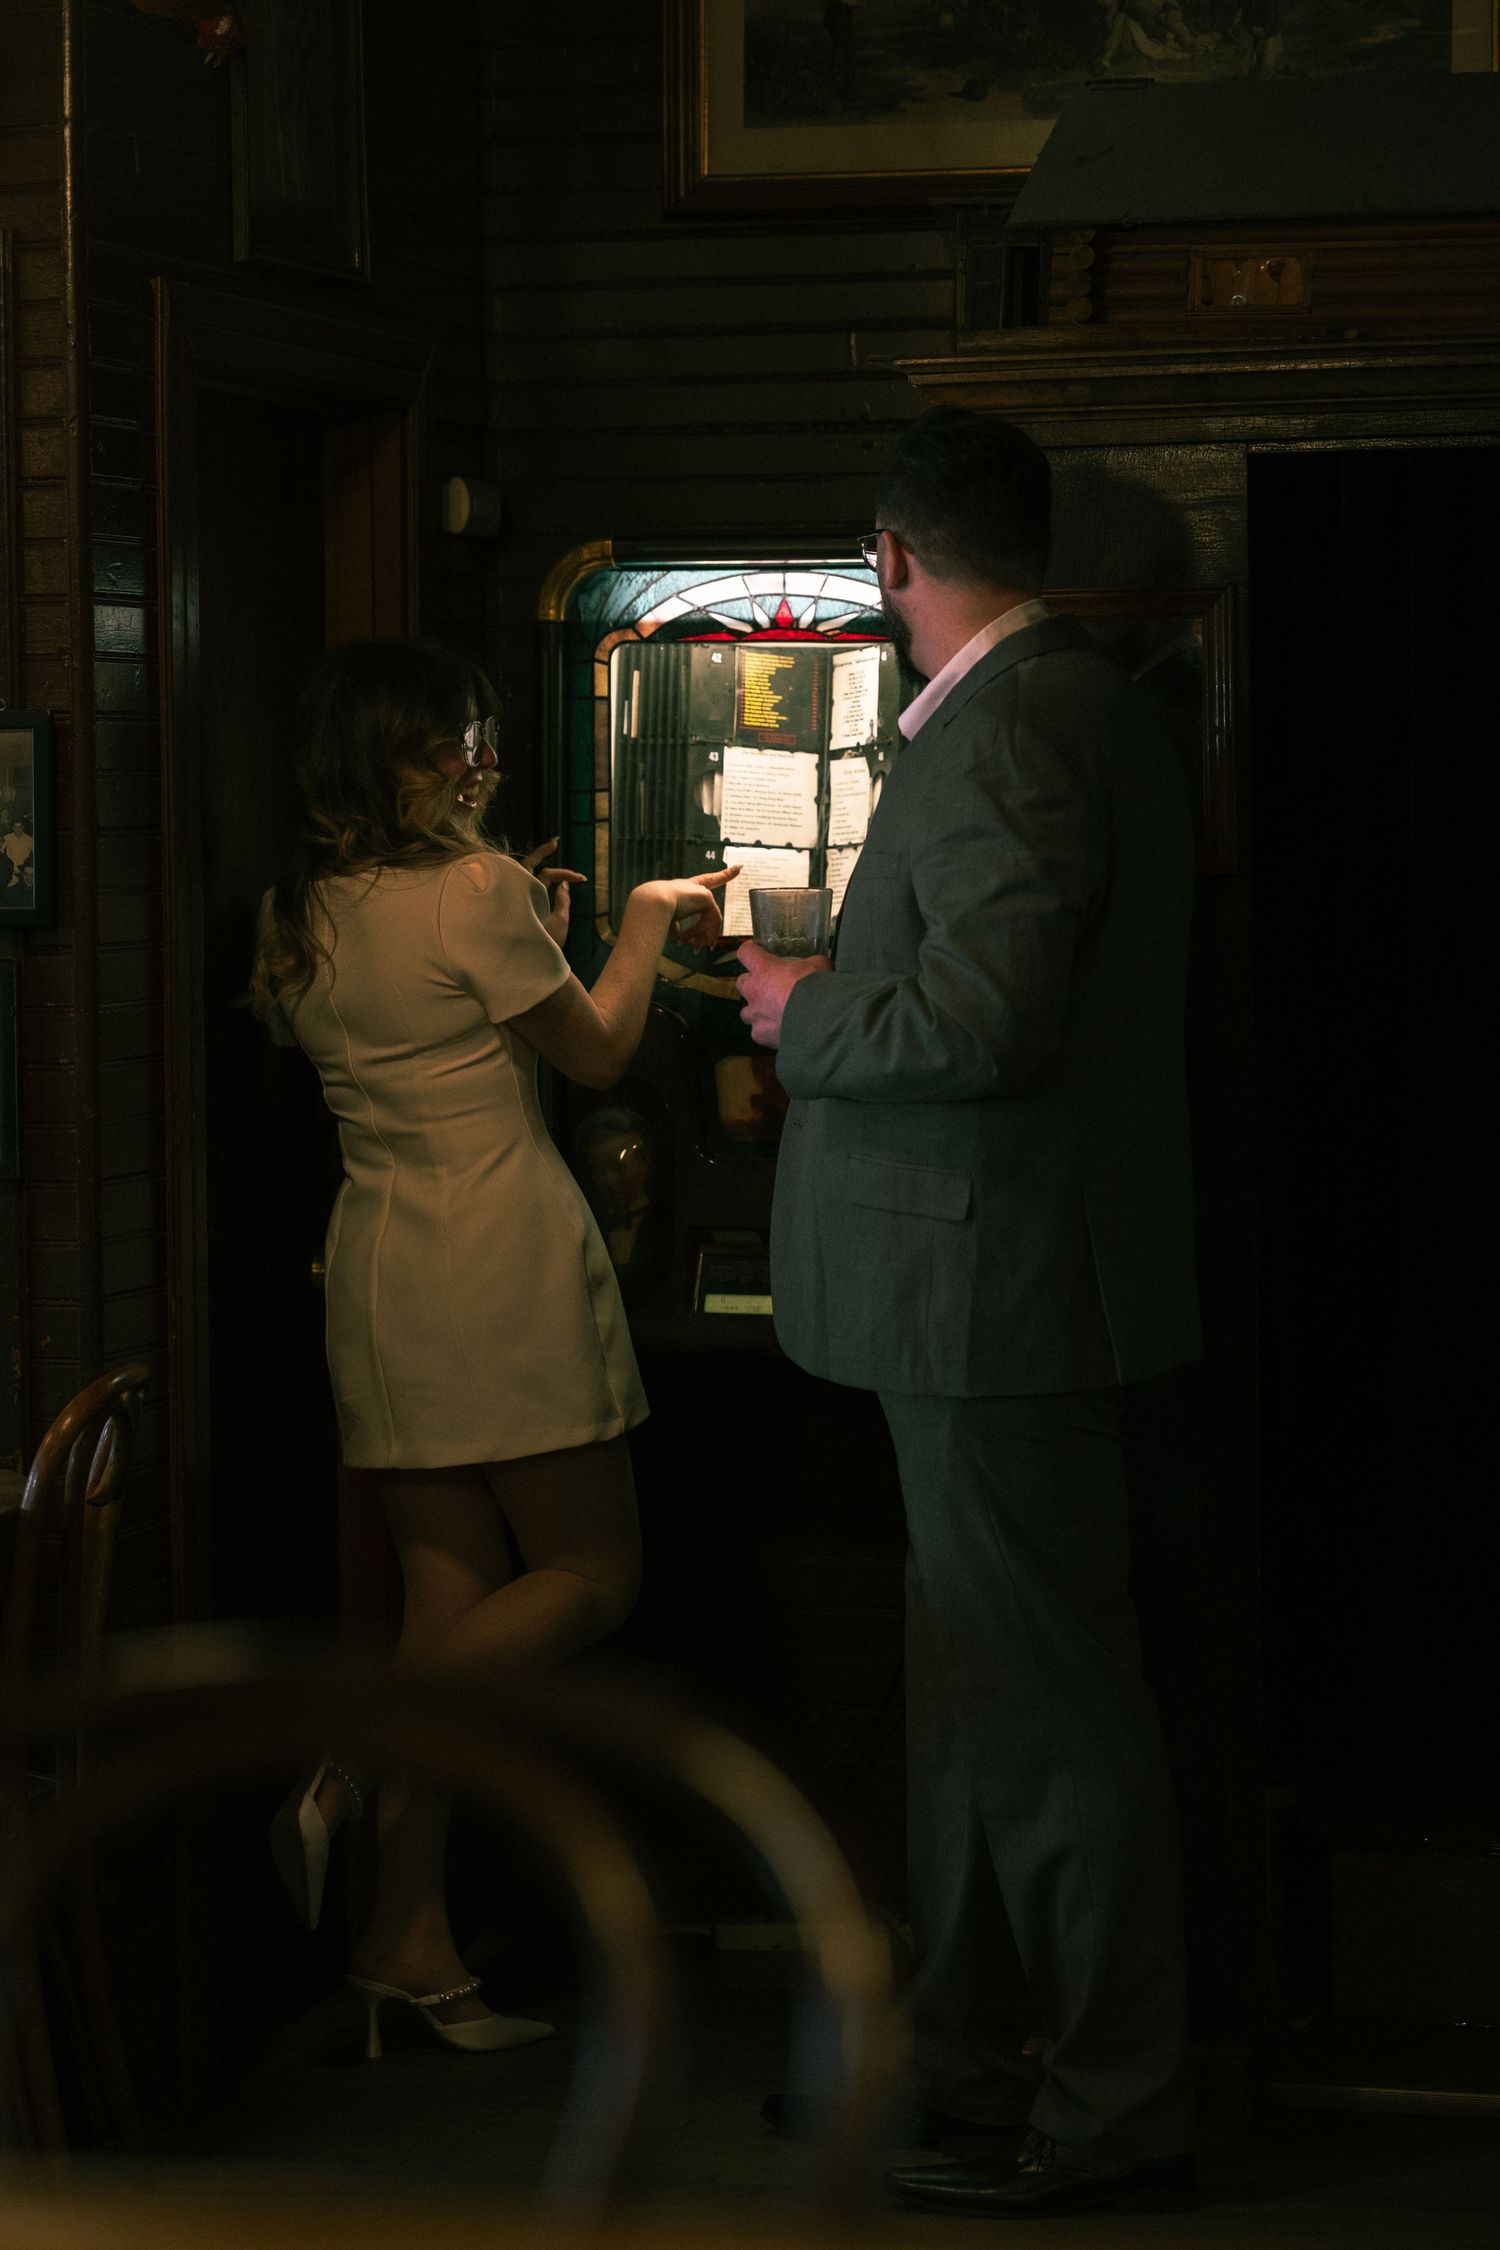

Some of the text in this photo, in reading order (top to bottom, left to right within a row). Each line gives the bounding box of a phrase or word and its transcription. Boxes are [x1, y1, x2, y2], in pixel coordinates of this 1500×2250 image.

[711, 652, 723, 664] 42
[709, 751, 719, 762] 43
[705, 850, 716, 861] 44
